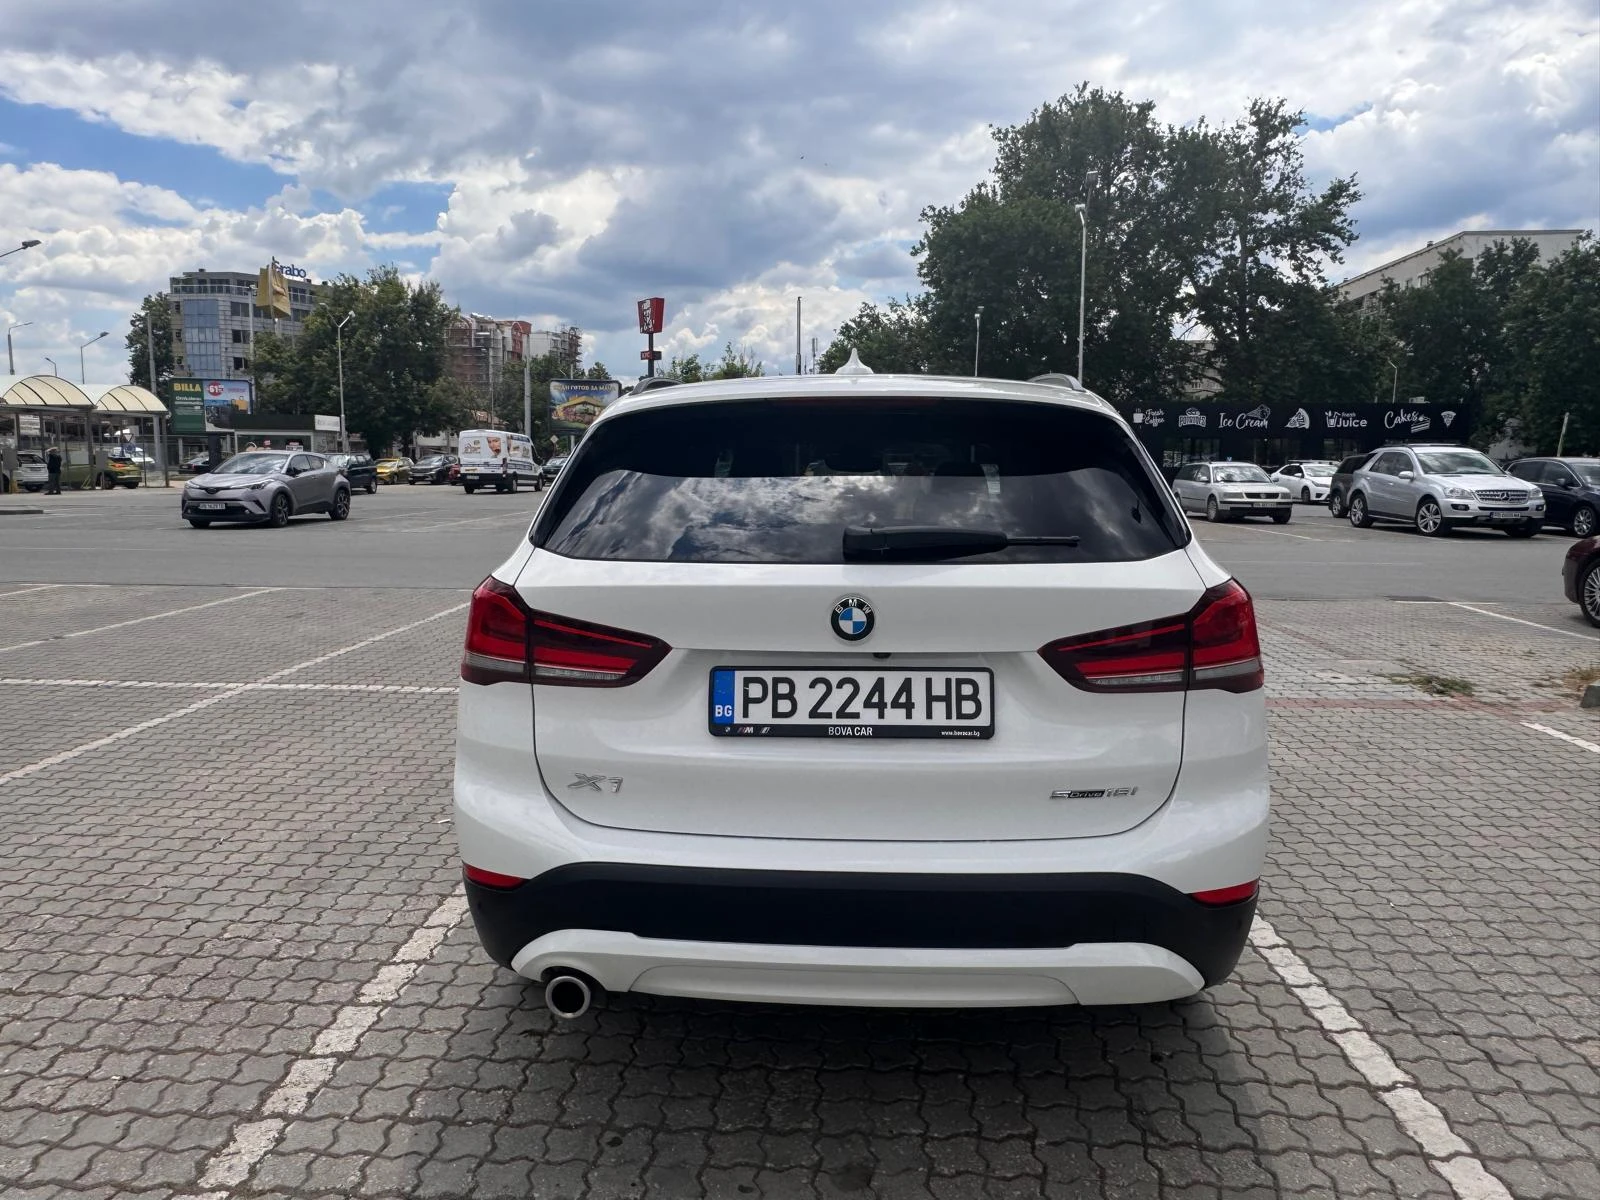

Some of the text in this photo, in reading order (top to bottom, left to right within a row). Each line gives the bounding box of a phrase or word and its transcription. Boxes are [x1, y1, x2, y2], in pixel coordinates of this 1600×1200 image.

[173, 383, 202, 392] BILLA
[1144, 415, 1165, 427] Coffee
[1218, 412, 1233, 429] Ice
[1235, 412, 1269, 430] Cream
[1336, 417, 1368, 428] Juice
[1384, 408, 1419, 429] Cakes
[835, 598, 872, 614] BMW
[715, 676, 983, 721] BG PB 2244 HB
[828, 726, 873, 736] BOVA CAR
[567, 772, 624, 793] X1
